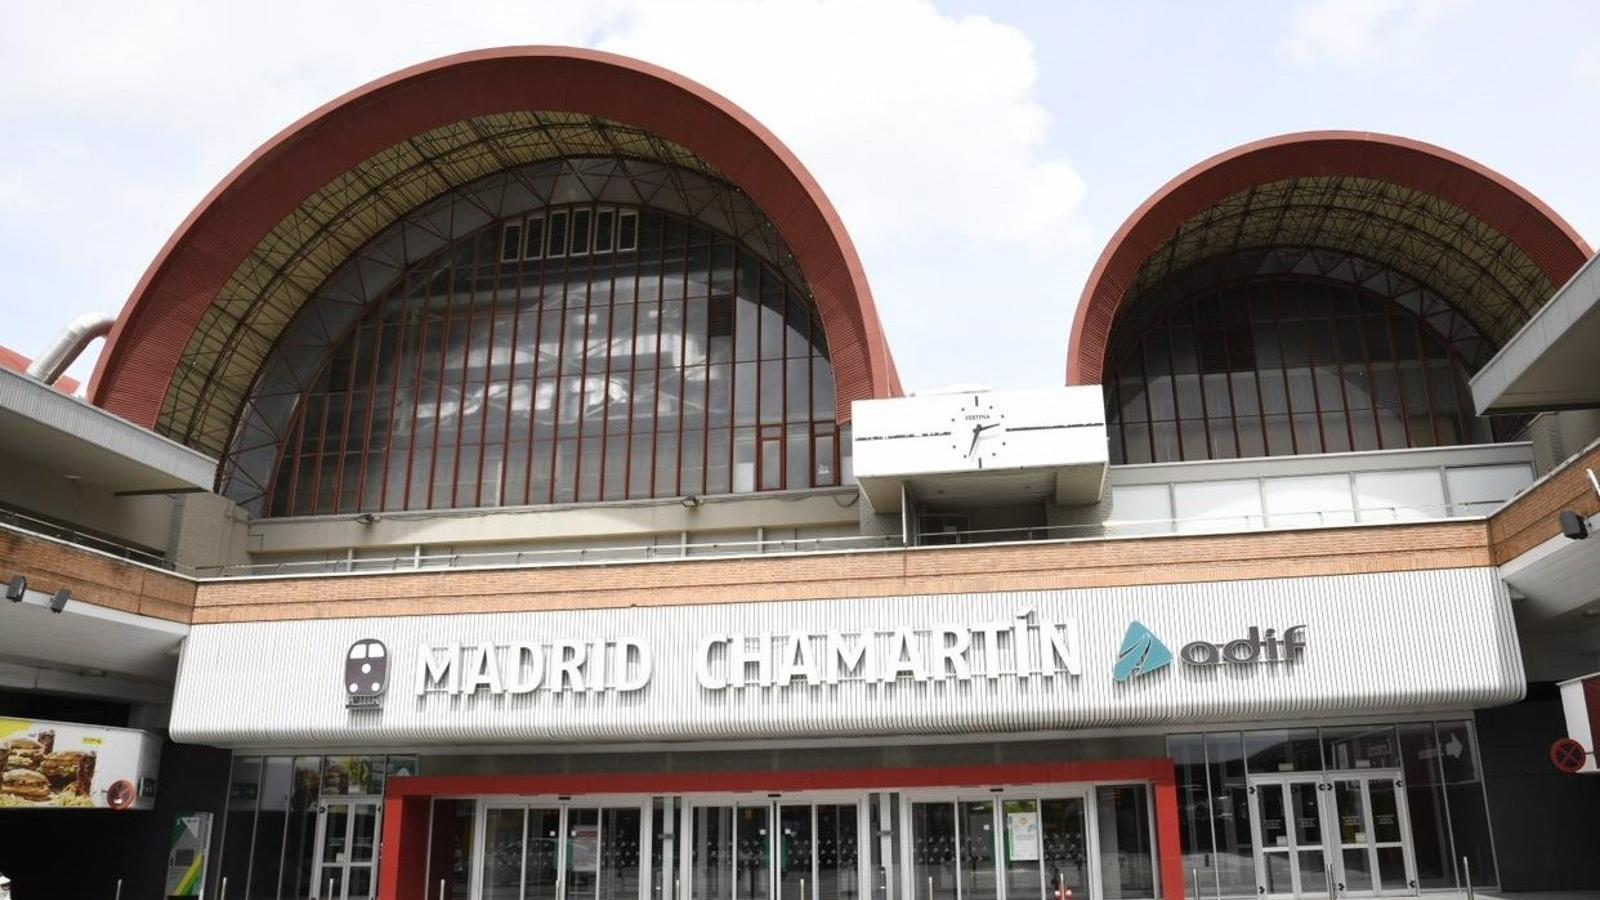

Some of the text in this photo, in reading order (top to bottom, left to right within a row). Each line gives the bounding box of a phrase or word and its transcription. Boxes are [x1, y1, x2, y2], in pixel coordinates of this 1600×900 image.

[415, 604, 1081, 695] MADRID CHAMARTÍN
[1180, 624, 1306, 665] adif
